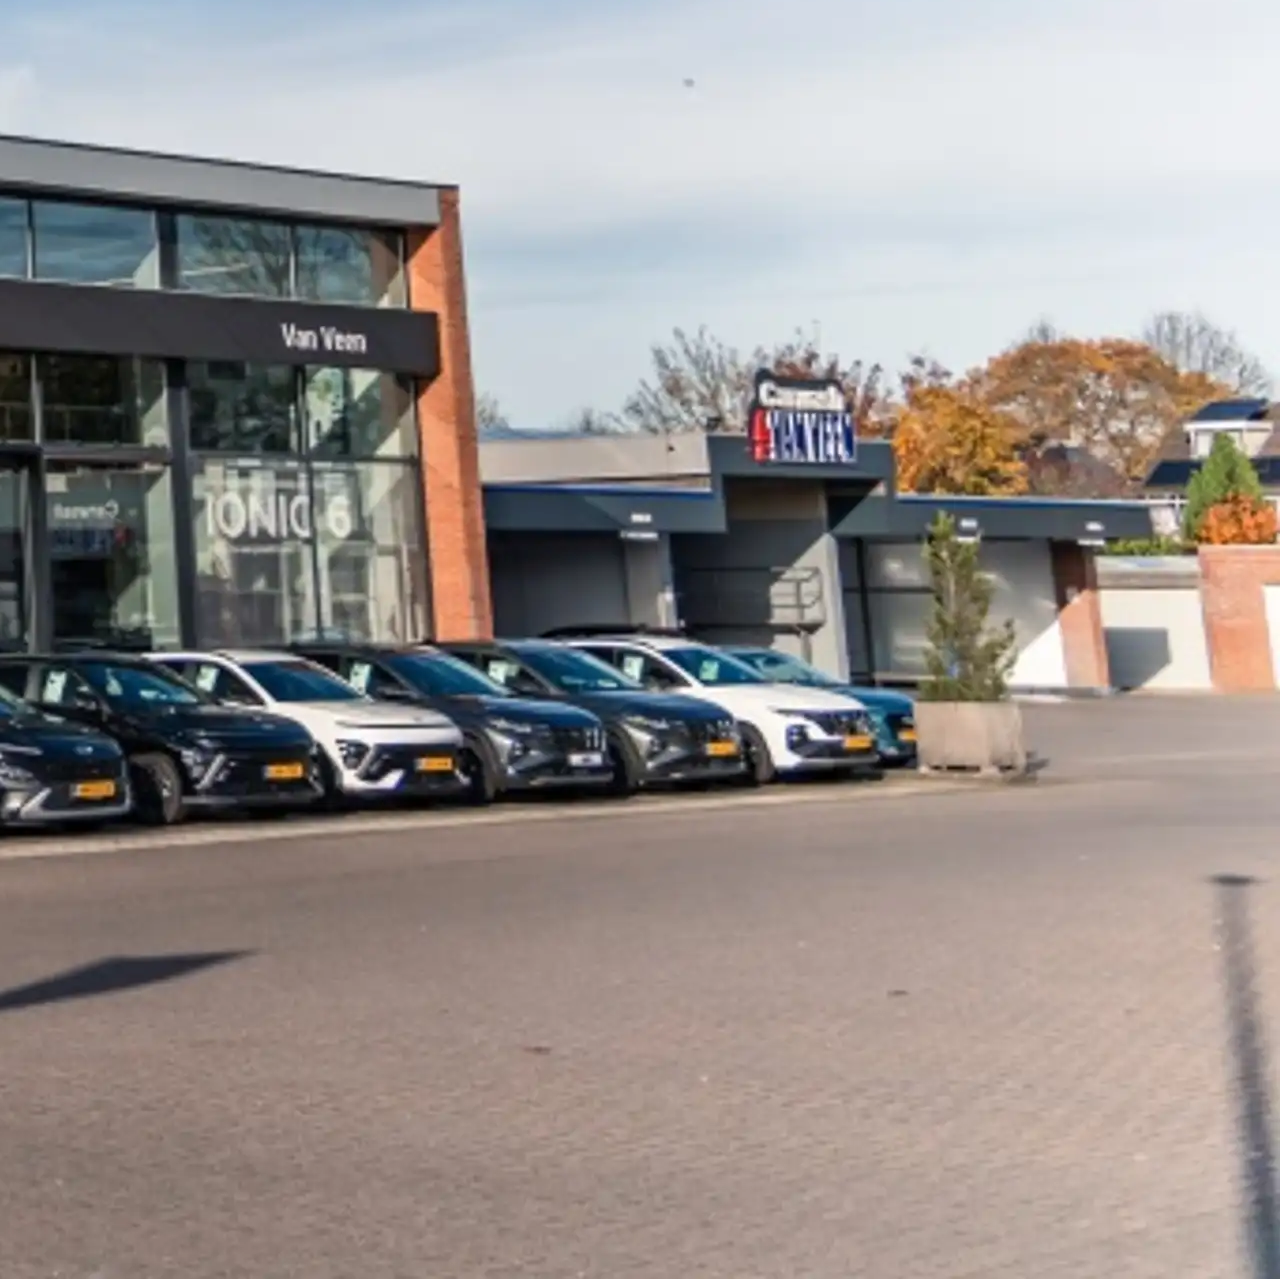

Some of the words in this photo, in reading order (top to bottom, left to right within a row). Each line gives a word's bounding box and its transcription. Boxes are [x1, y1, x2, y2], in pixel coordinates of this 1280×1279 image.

[280, 322, 318, 350] Van
[319, 325, 367, 354] Veen
[327, 494, 352, 539] 6
